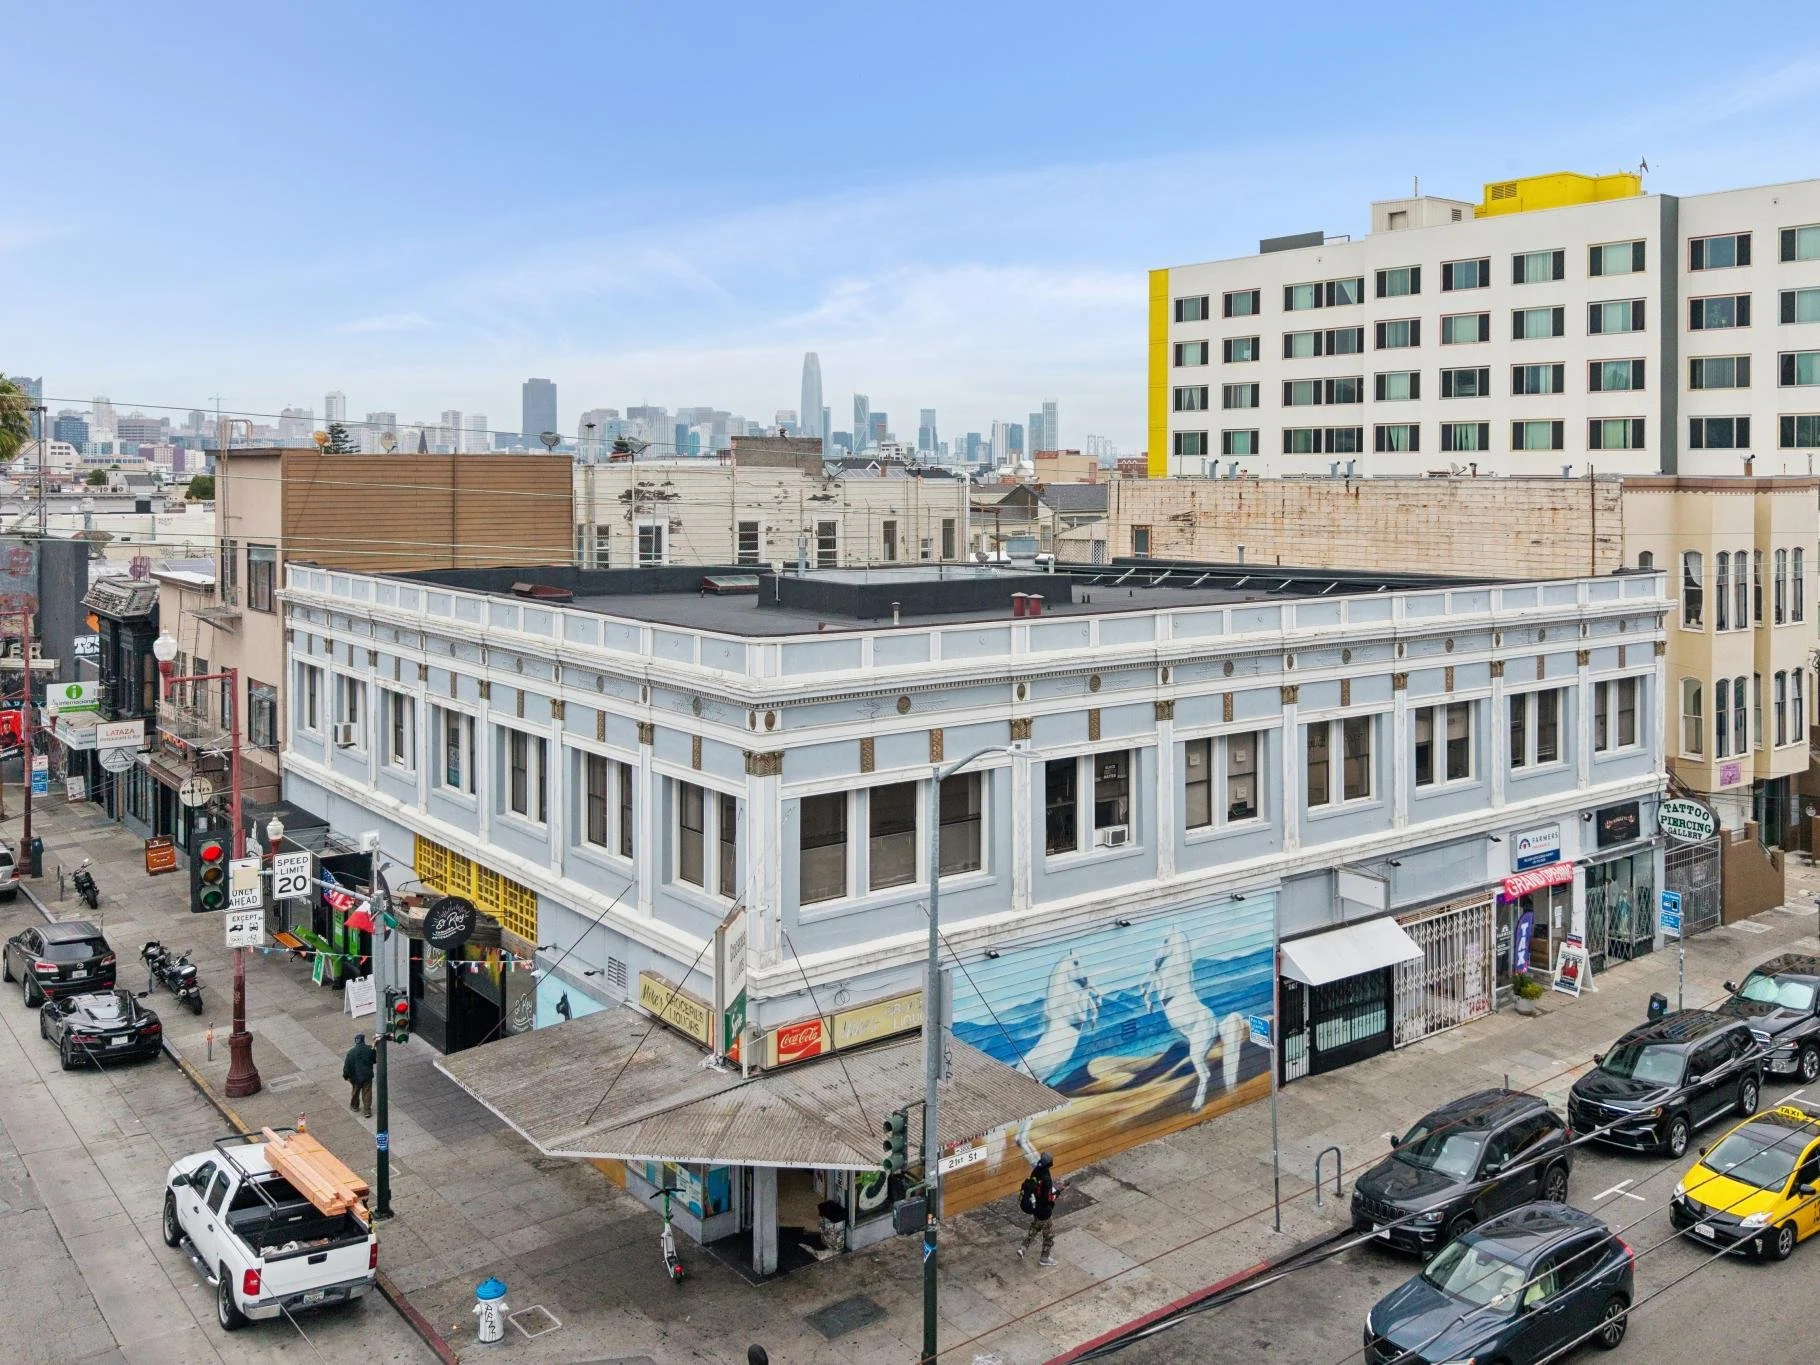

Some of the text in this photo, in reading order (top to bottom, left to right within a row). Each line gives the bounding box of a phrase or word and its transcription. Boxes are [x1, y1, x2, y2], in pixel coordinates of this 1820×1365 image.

[1664, 803, 1710, 821] TATTOO
[1660, 815, 1712, 834] PIERCING
[1532, 832, 1559, 842] FARMERS
[1668, 827, 1703, 840] GALLERY
[277, 857, 309, 867] SPEED
[280, 866, 305, 875] LIMIT
[278, 875, 307, 894] 20
[1506, 871, 1547, 897] GRAND
[232, 914, 257, 922] EXCEPT
[1518, 922, 1529, 967] TAX
[1781, 1107, 1800, 1117] TAXI
[949, 1152, 977, 1169] 21st St
